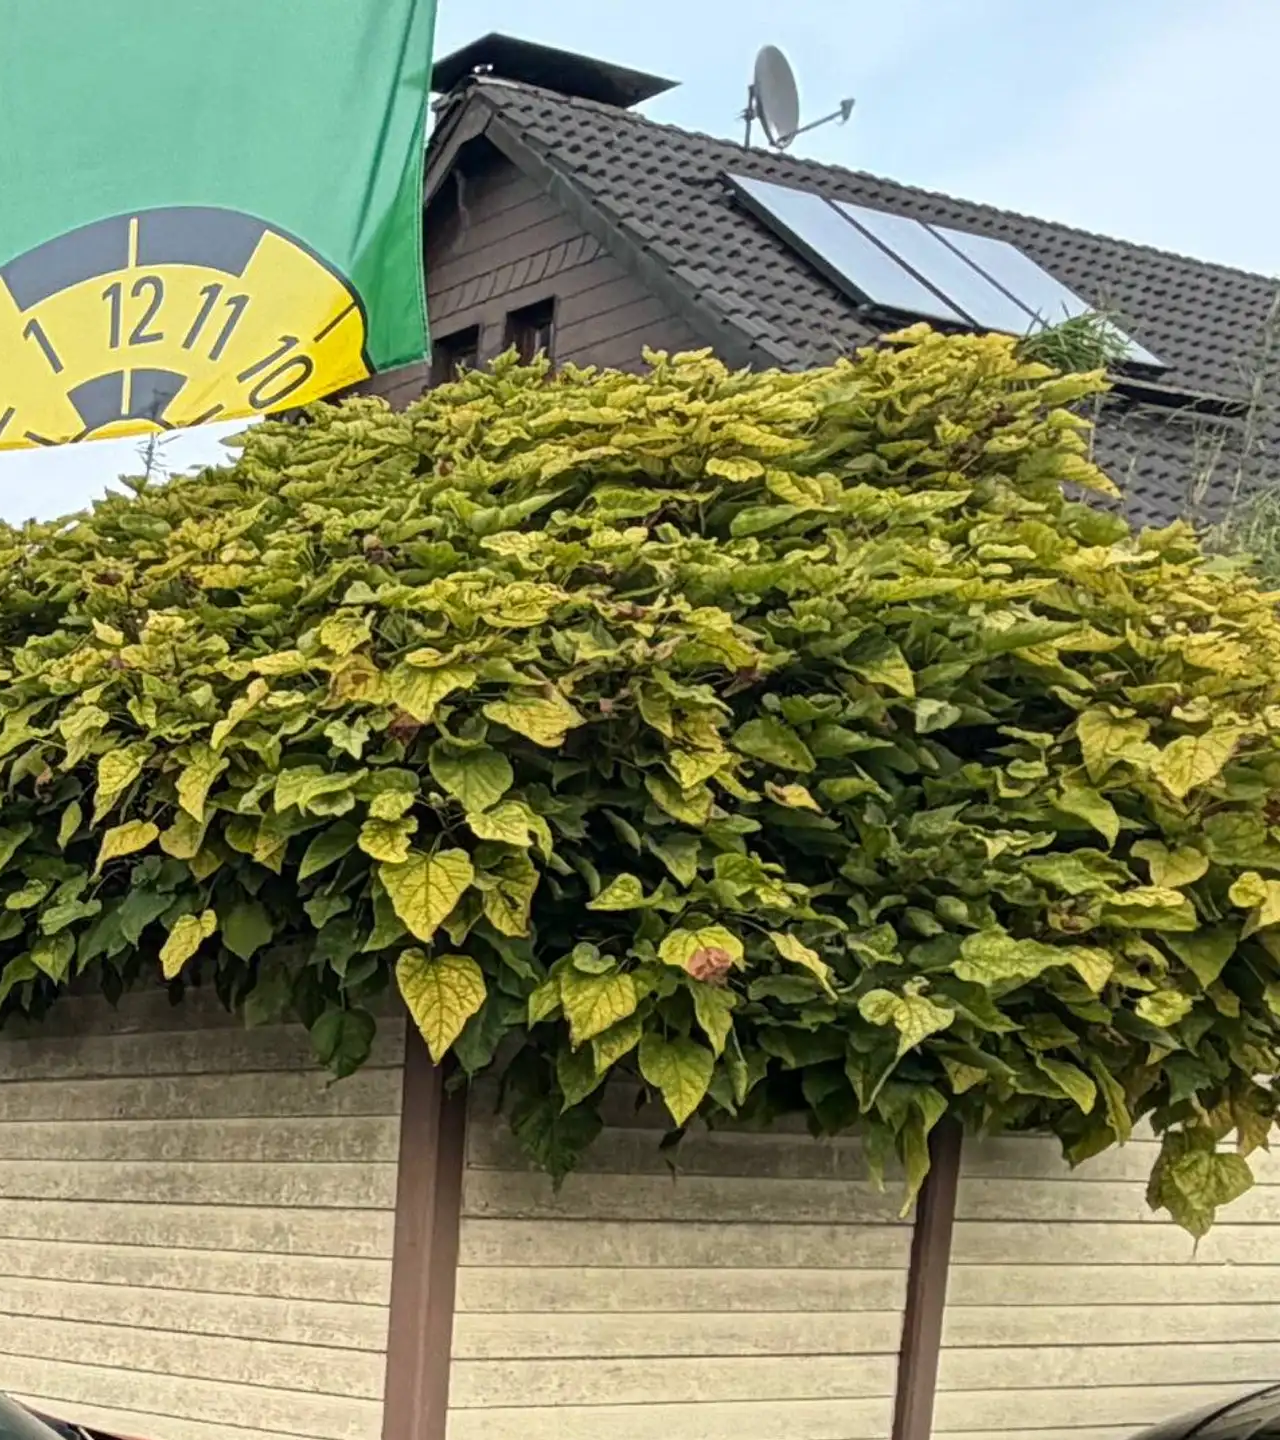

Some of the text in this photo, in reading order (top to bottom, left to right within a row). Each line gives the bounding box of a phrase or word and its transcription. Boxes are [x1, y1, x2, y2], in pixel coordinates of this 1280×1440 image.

[101, 276, 164, 349] 12
[182, 283, 250, 361] 11
[237, 335, 314, 410] 10
